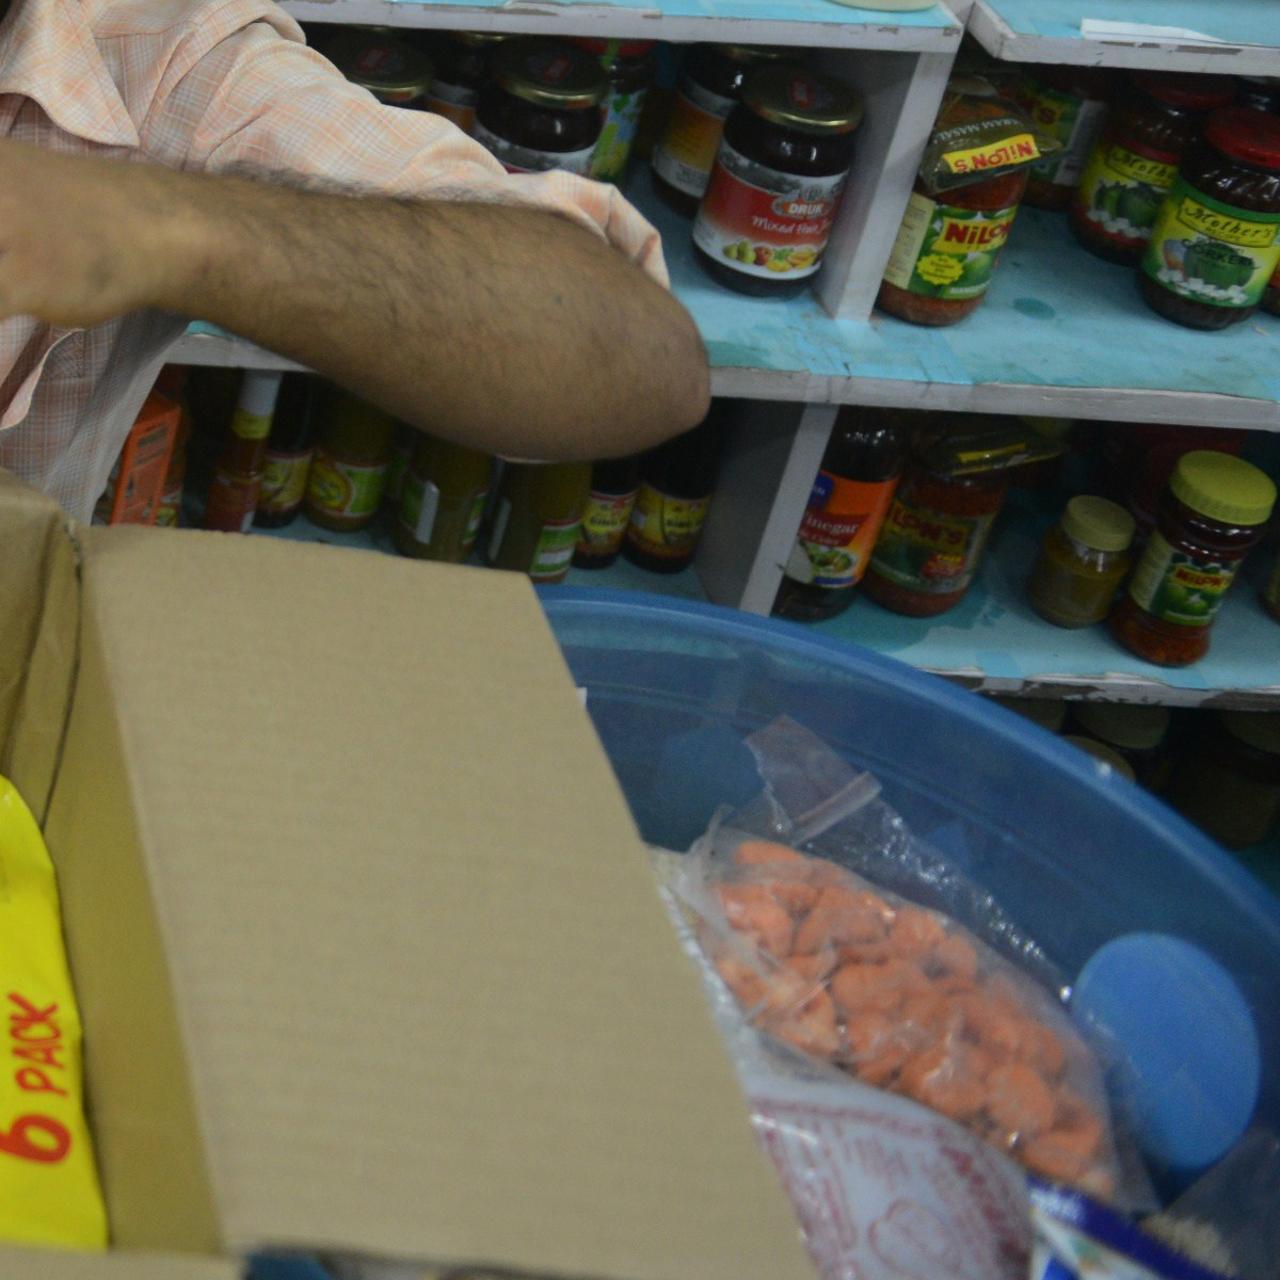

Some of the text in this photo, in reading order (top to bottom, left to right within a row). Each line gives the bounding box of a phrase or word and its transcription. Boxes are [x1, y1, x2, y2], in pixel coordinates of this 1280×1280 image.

[787, 201, 825, 217] DRUK
[752, 215, 795, 233] Mixed
[1184, 206, 1273, 240] Mother's
[7, 991, 68, 1098] PACK
